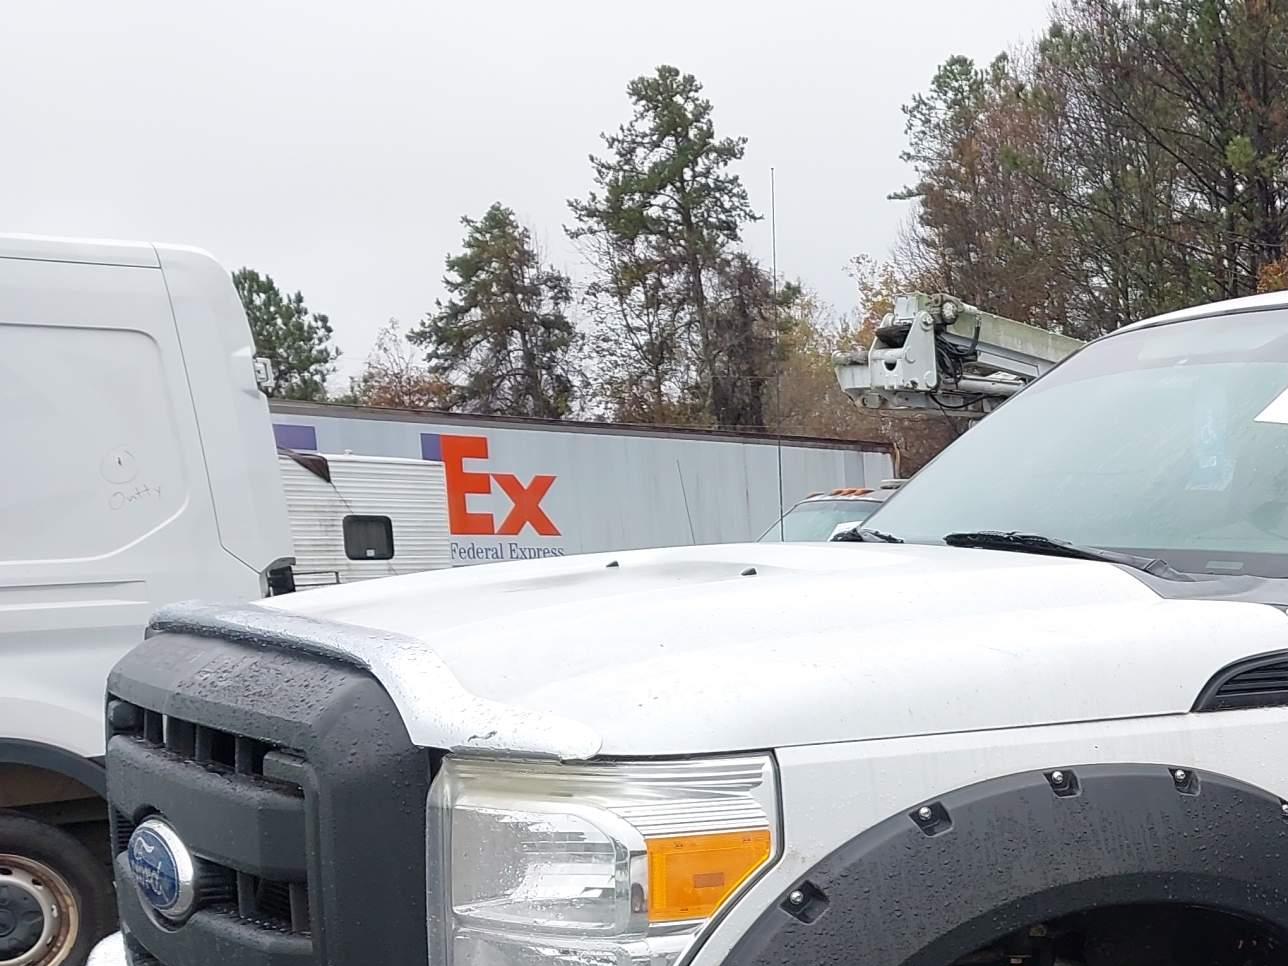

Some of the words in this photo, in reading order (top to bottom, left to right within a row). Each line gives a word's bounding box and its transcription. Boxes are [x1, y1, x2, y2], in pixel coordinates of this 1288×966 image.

[450, 542, 504, 560] Federal
[509, 543, 565, 560] Express
[130, 836, 165, 899] Ford
